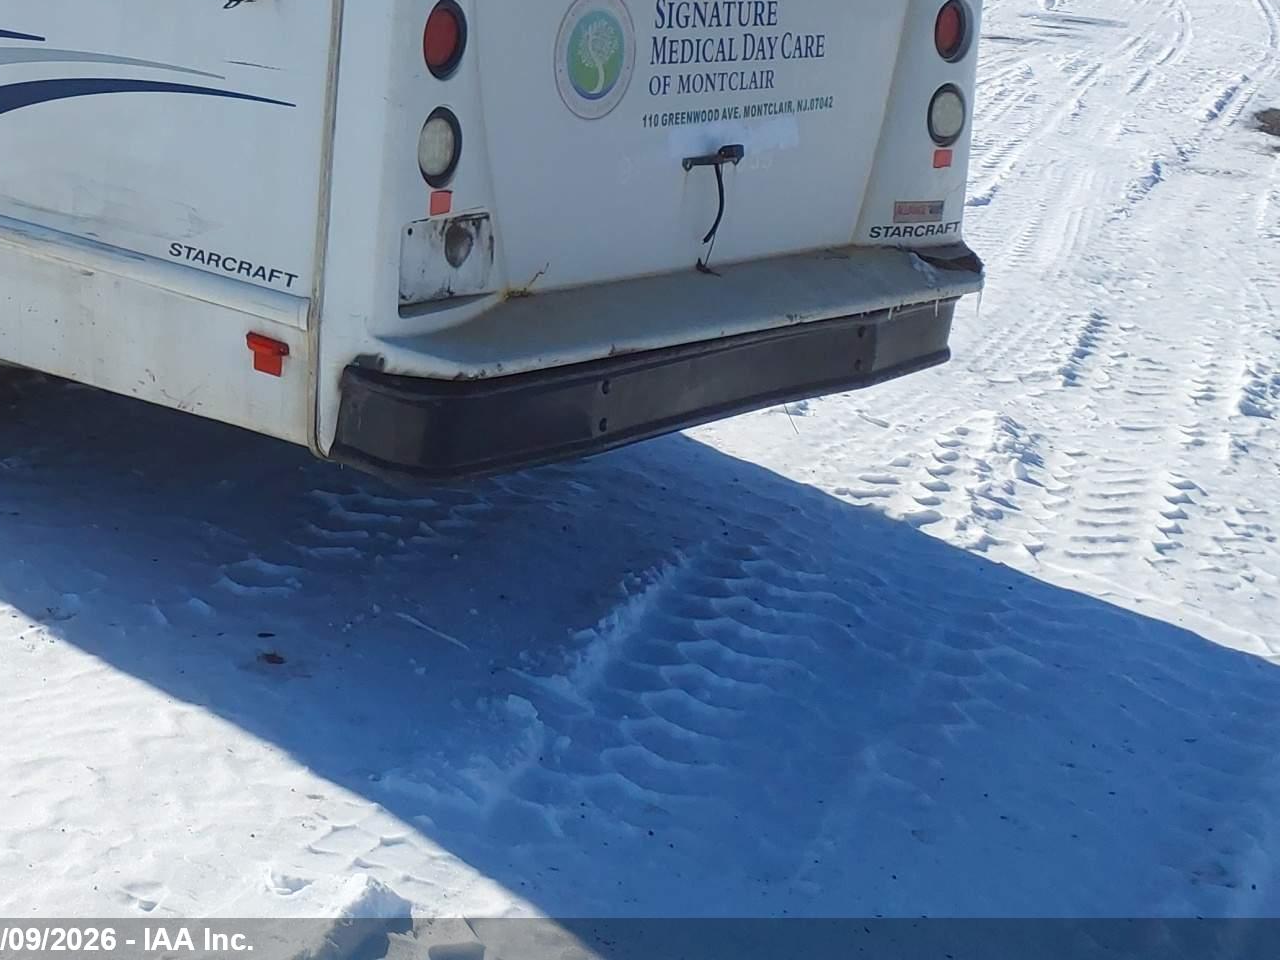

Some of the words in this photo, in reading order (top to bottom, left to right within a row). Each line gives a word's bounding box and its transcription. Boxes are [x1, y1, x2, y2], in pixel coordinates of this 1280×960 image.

[649, 35, 737, 65] MEDICAL
[741, 32, 777, 62] DAY
[781, 32, 825, 59] CARE
[648, 75, 671, 96] OF
[677, 70, 775, 94] MONTCLAIR
[642, 113, 659, 128] 110
[661, 108, 720, 127] GREENWOOD
[869, 221, 961, 239] STARCRAFT
[169, 242, 299, 288] STARCRAFT
